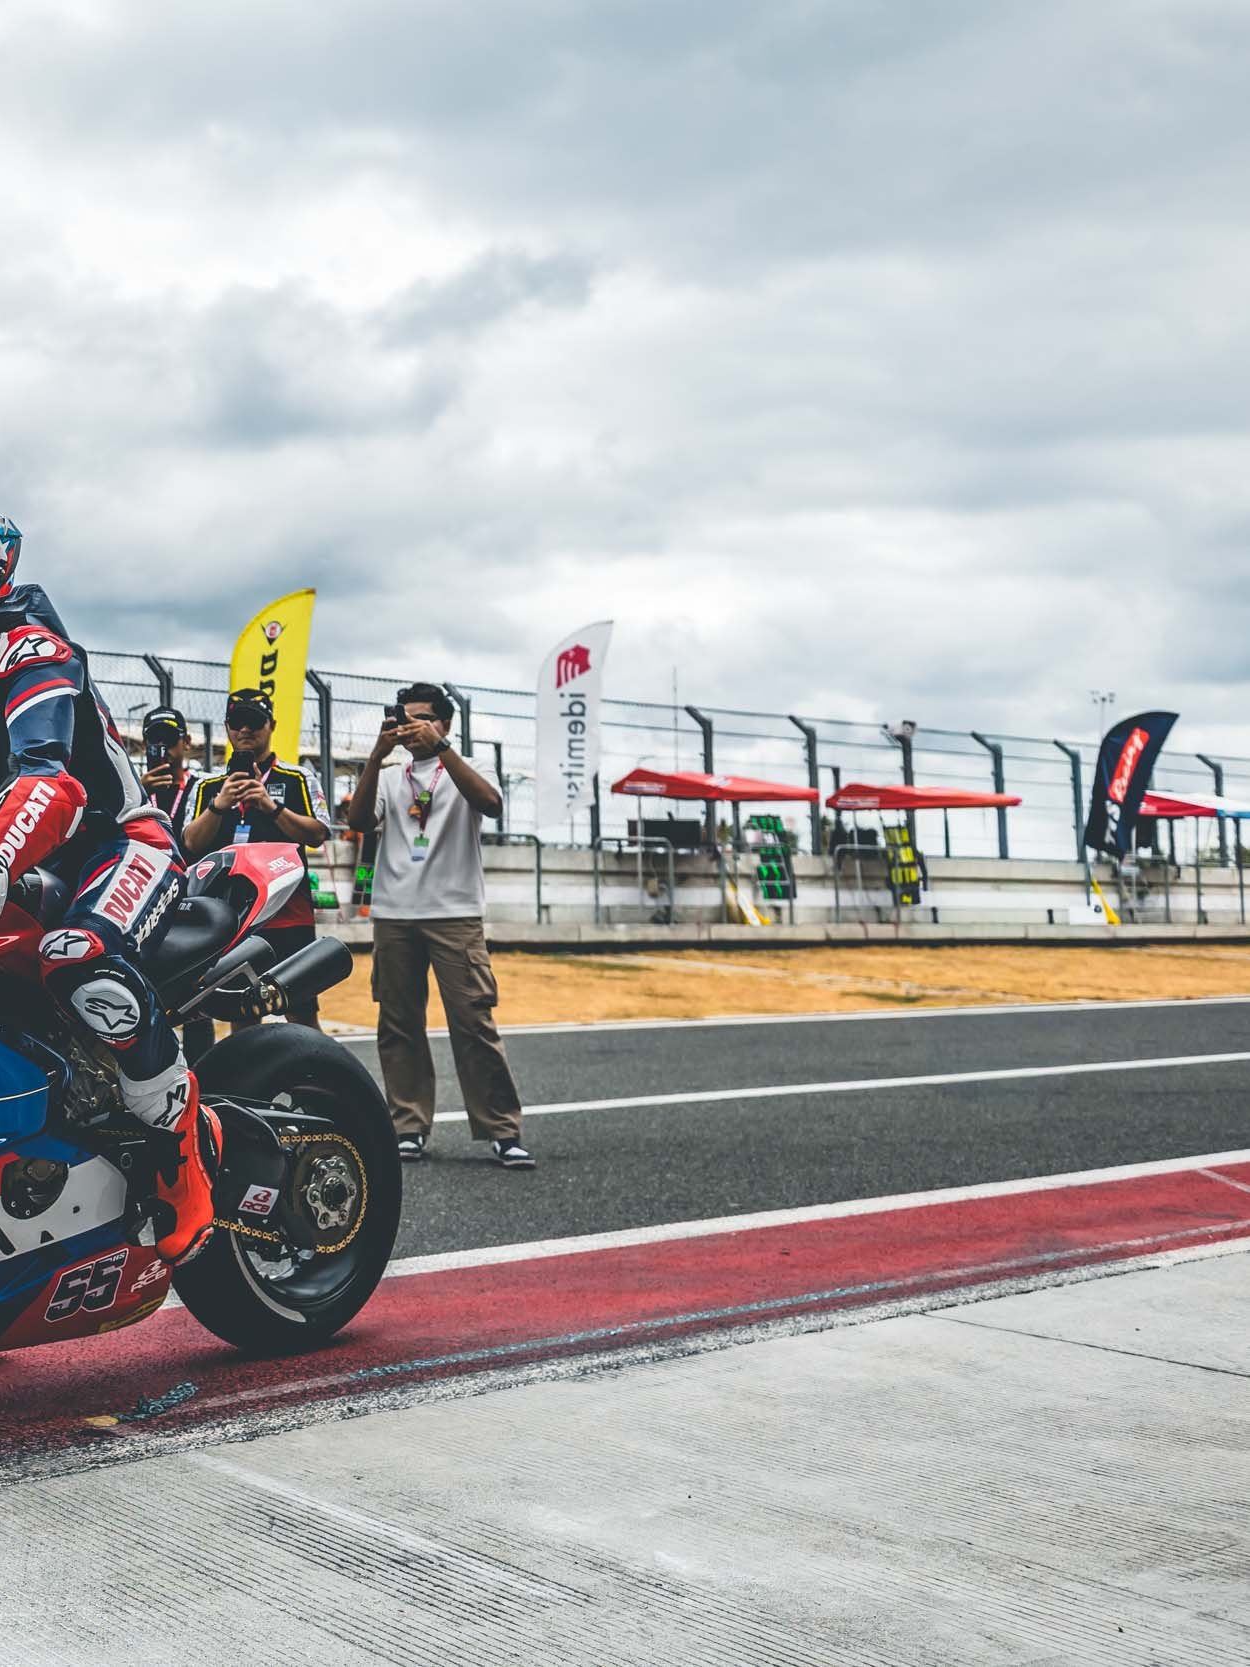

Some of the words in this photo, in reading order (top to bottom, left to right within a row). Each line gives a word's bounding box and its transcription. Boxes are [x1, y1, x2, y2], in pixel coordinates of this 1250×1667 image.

[103, 853, 156, 925] DUCATI
[133, 878, 180, 953] pinestars
[241, 1201, 271, 1213] RCB
[44, 1248, 129, 1323] 55
[130, 1268, 168, 1292] RCB
